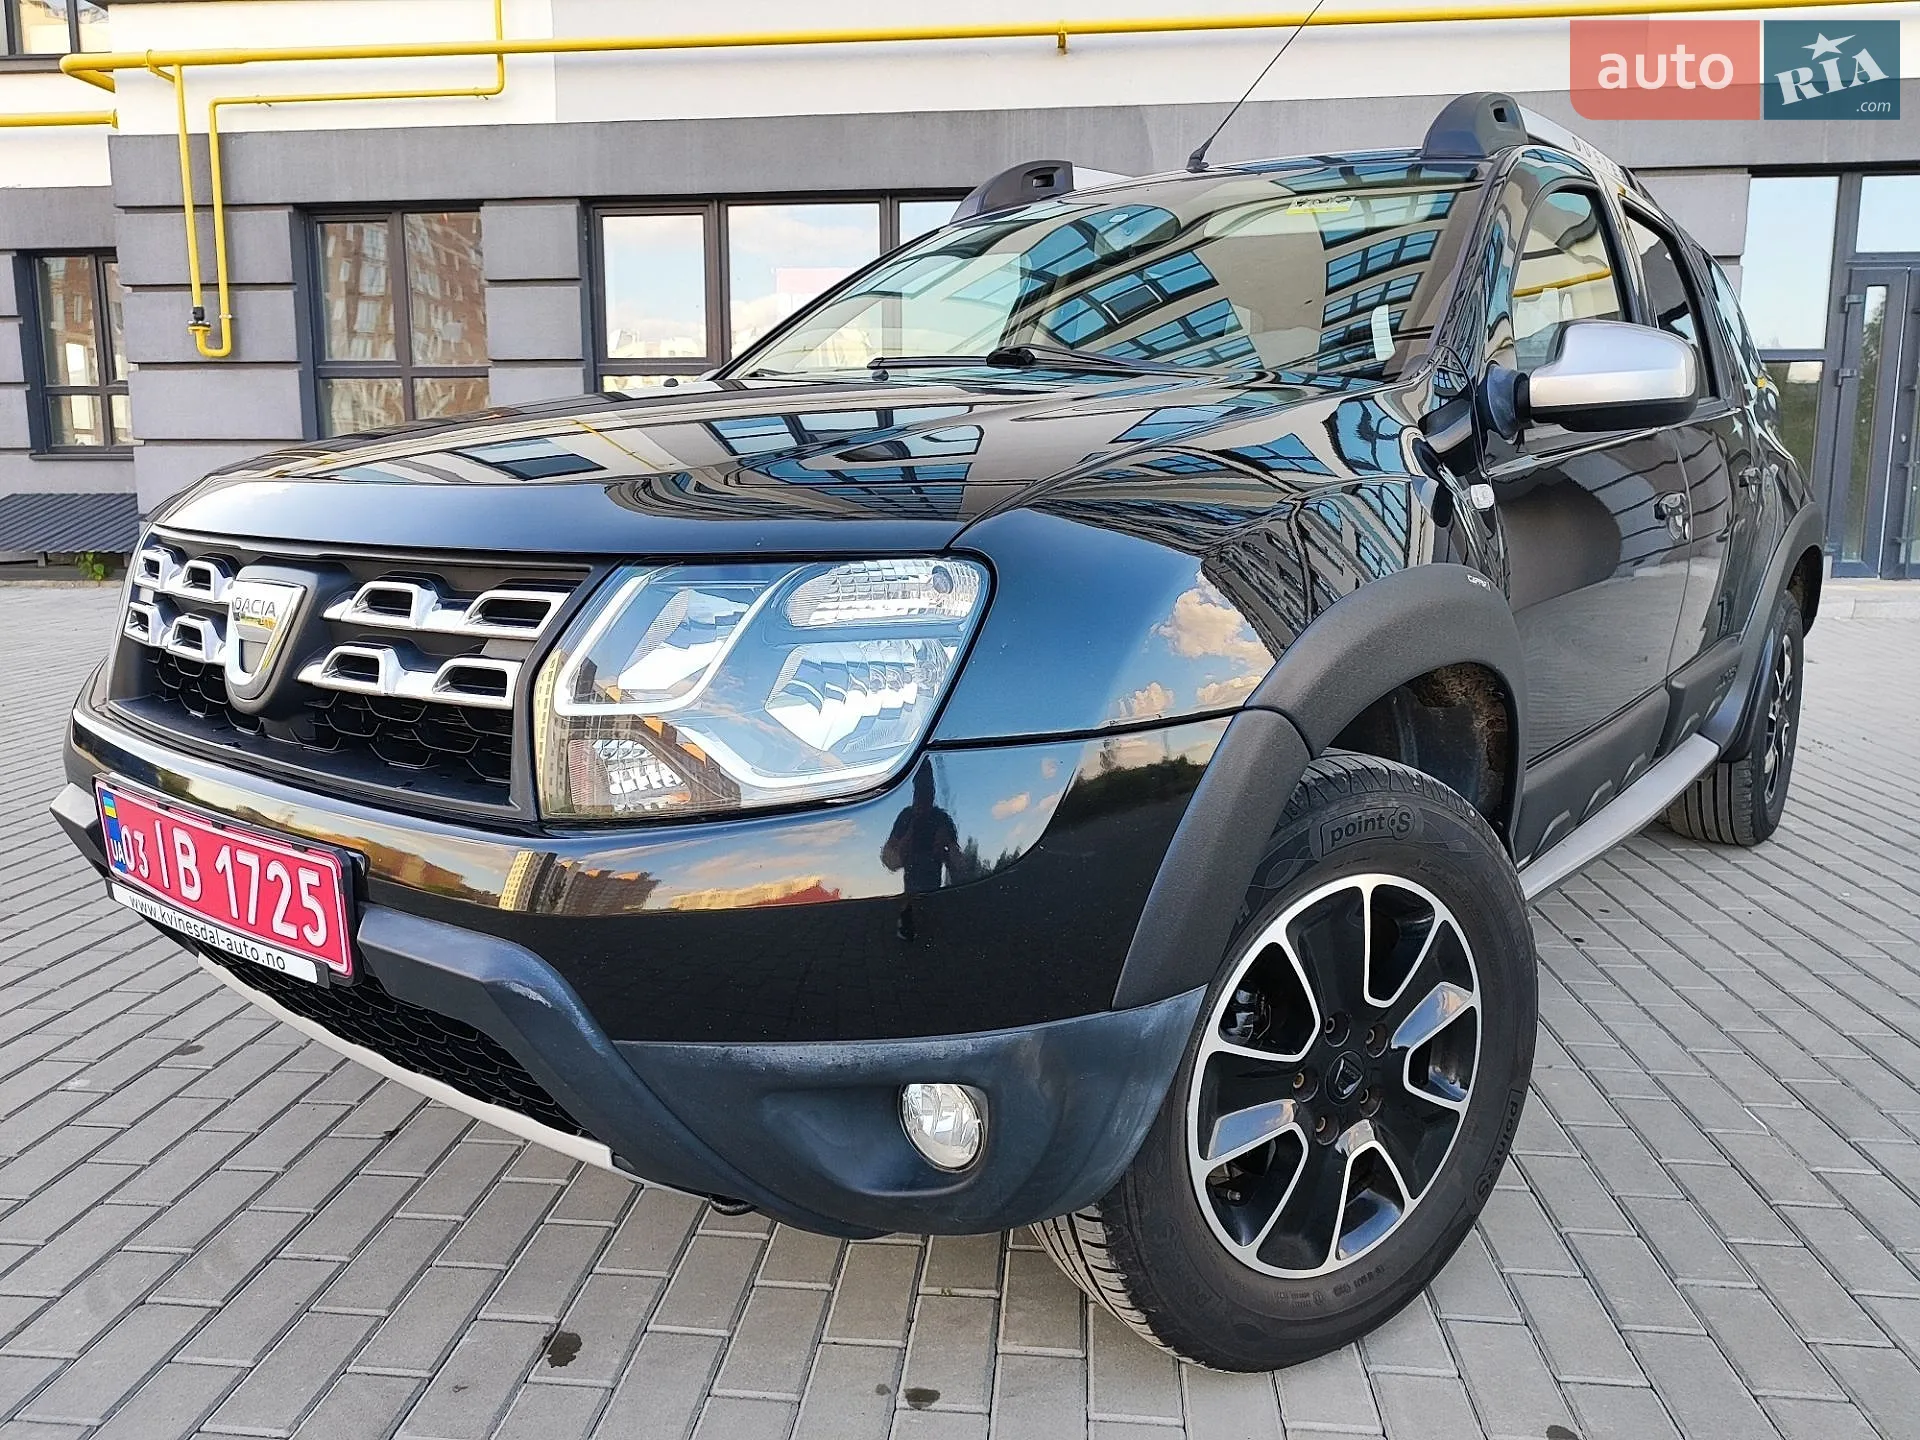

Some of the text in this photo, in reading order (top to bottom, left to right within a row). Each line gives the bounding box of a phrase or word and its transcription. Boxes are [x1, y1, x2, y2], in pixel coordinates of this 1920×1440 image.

[232, 596, 276, 617] DACIA
[109, 838, 126, 865] UA
[121, 824, 150, 879] 03
[214, 844, 328, 948] 1725
[128, 894, 286, 971] www.kvinesdal-auto.no
